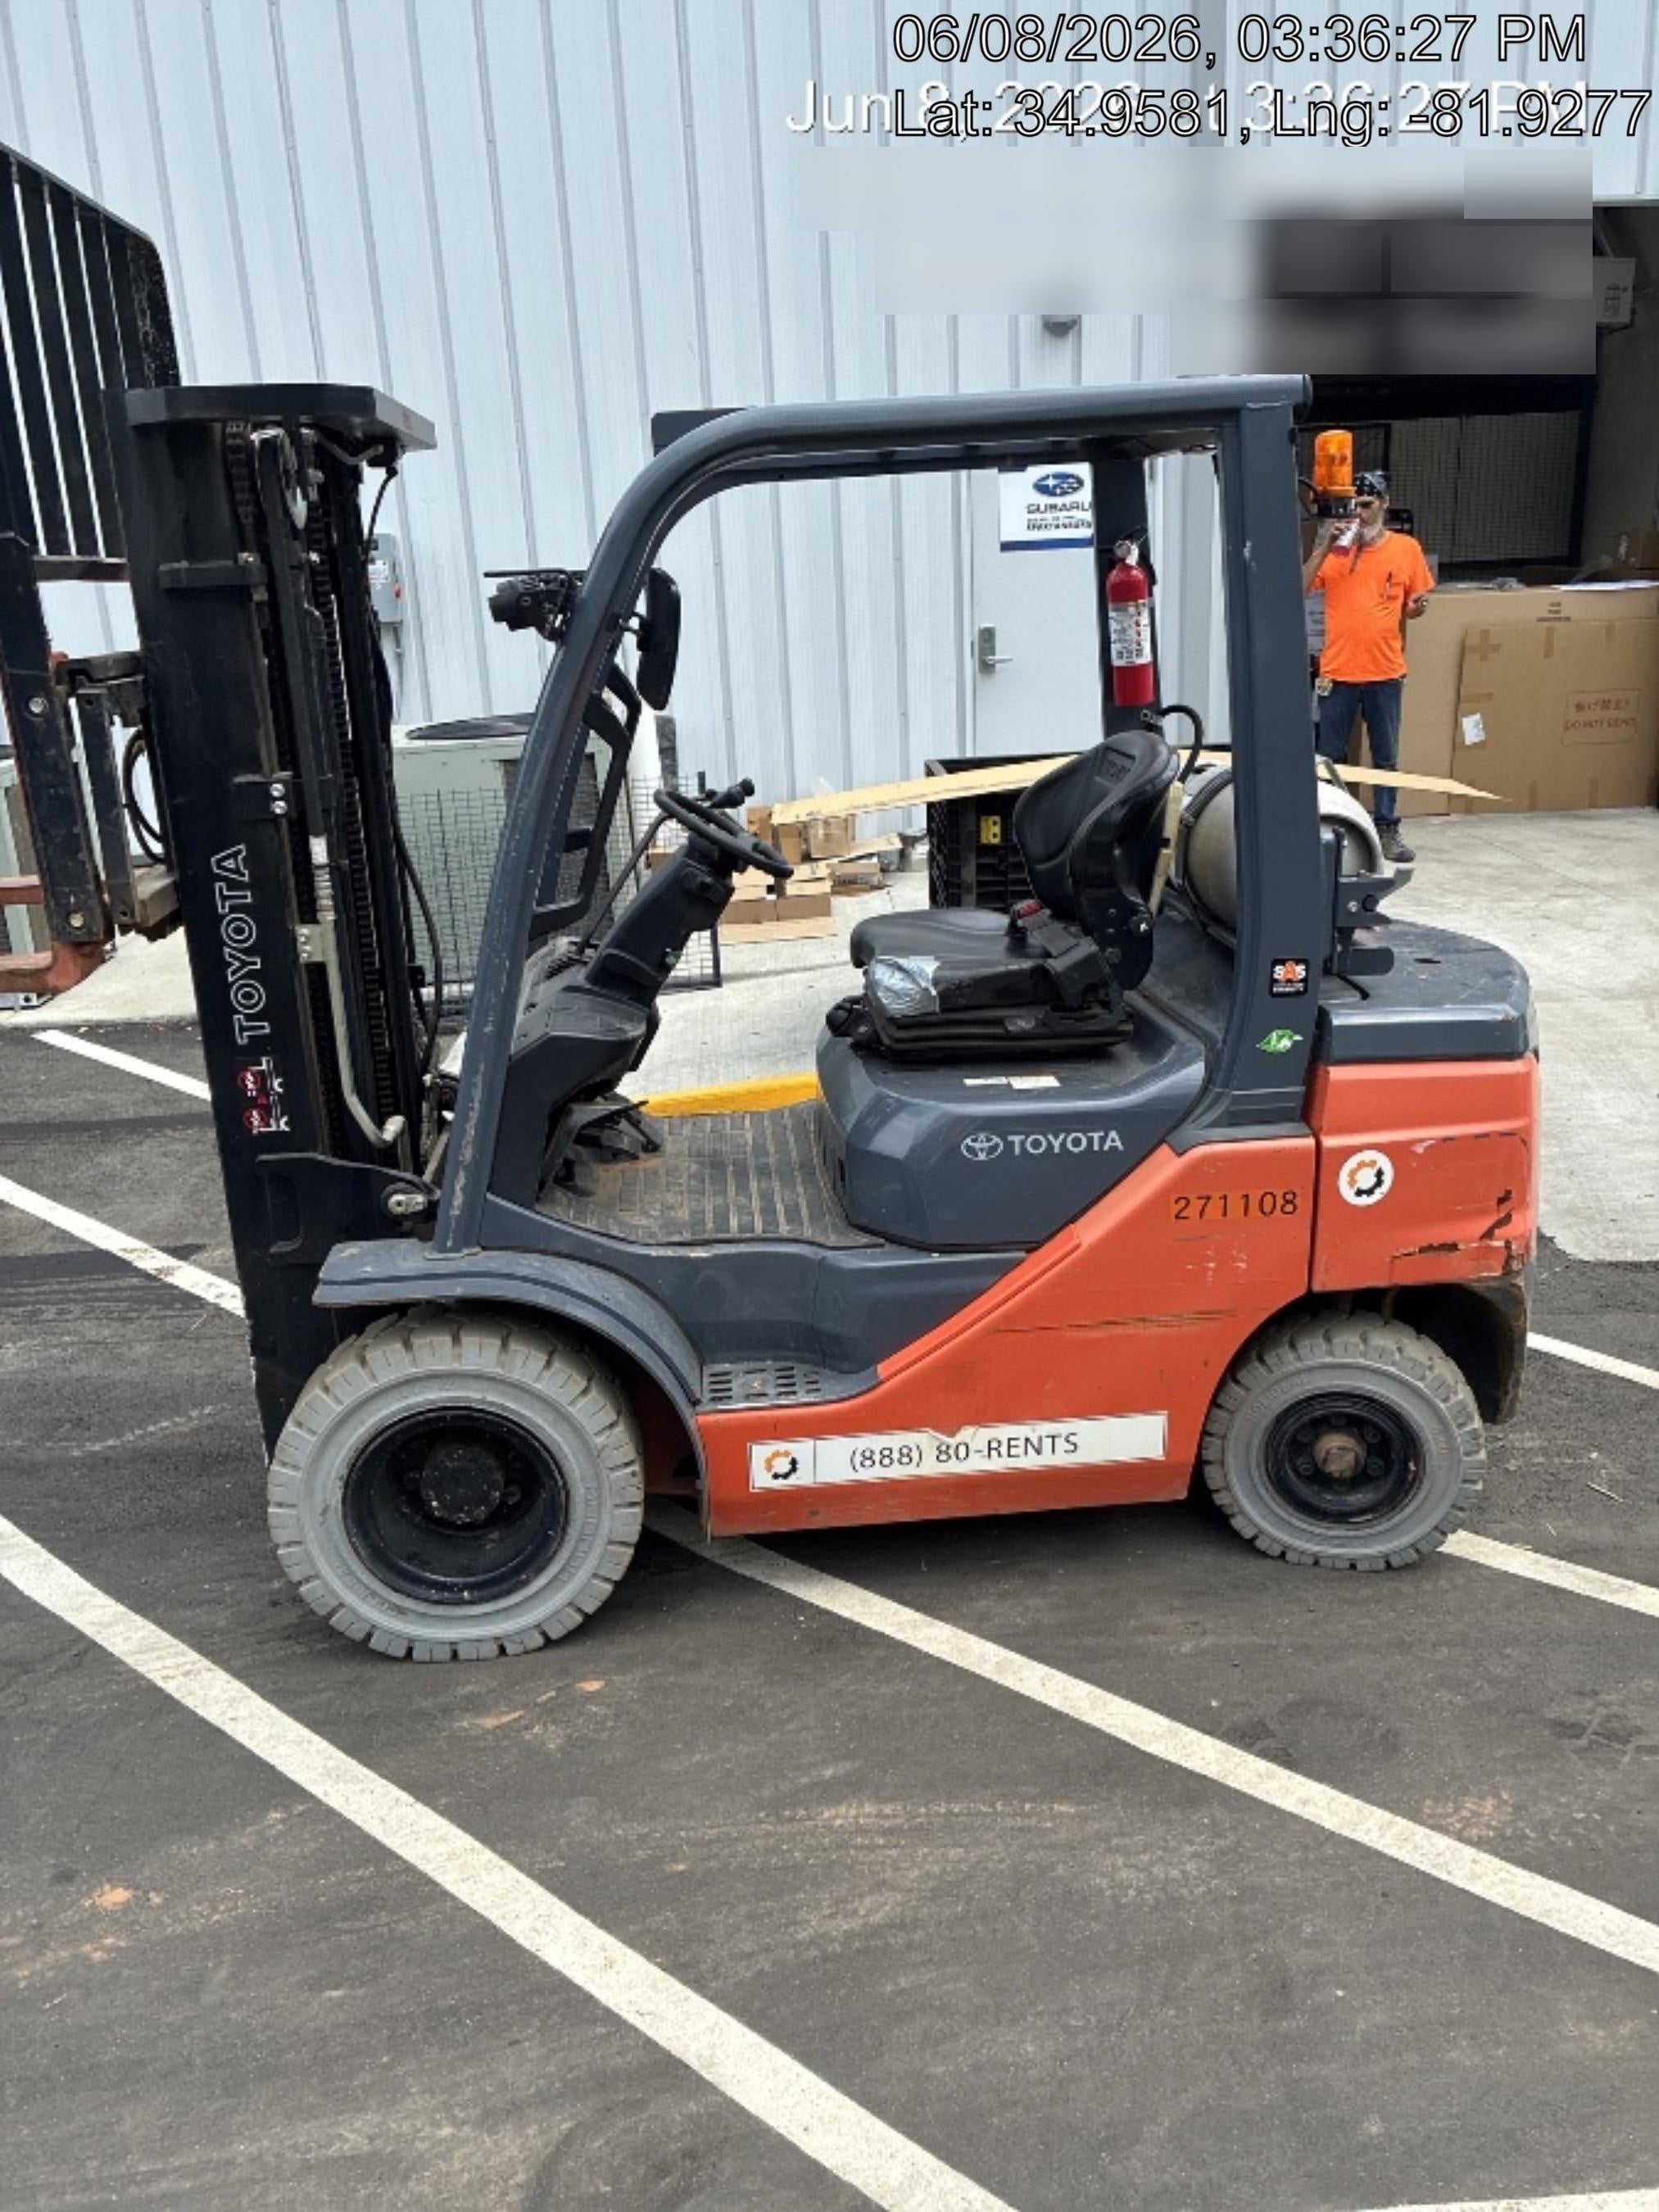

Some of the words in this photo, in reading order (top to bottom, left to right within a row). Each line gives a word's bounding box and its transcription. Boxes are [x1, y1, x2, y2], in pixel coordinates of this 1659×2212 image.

[211, 843, 271, 1045] TOYOTA
[1008, 1130, 1124, 1155] TOYOTA
[1173, 1190, 1299, 1220] 271108
[850, 1444, 923, 1473] (888)
[936, 1432, 1079, 1464] 80-RENTS
